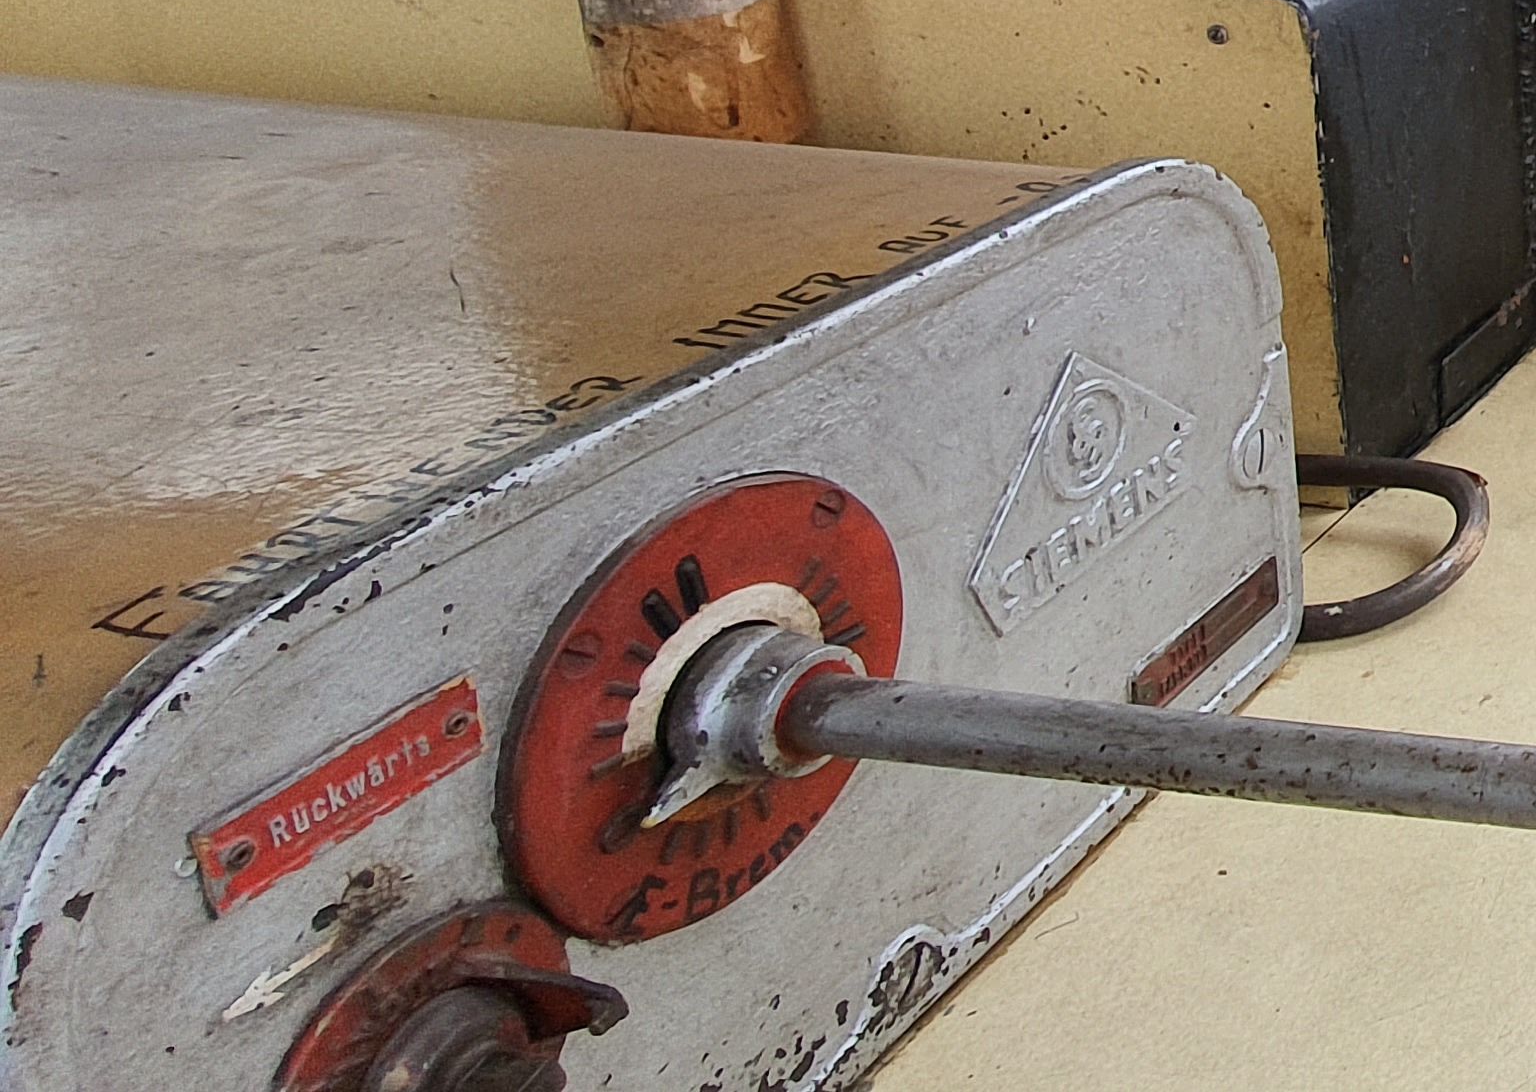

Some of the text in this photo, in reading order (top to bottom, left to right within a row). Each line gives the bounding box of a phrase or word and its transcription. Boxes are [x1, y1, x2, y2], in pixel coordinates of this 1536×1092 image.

[672, 271, 879, 350] IMMER
[878, 214, 970, 254] AUF
[1000, 438, 1184, 611] SIEMENS
[269, 735, 432, 848] Rückwärts
